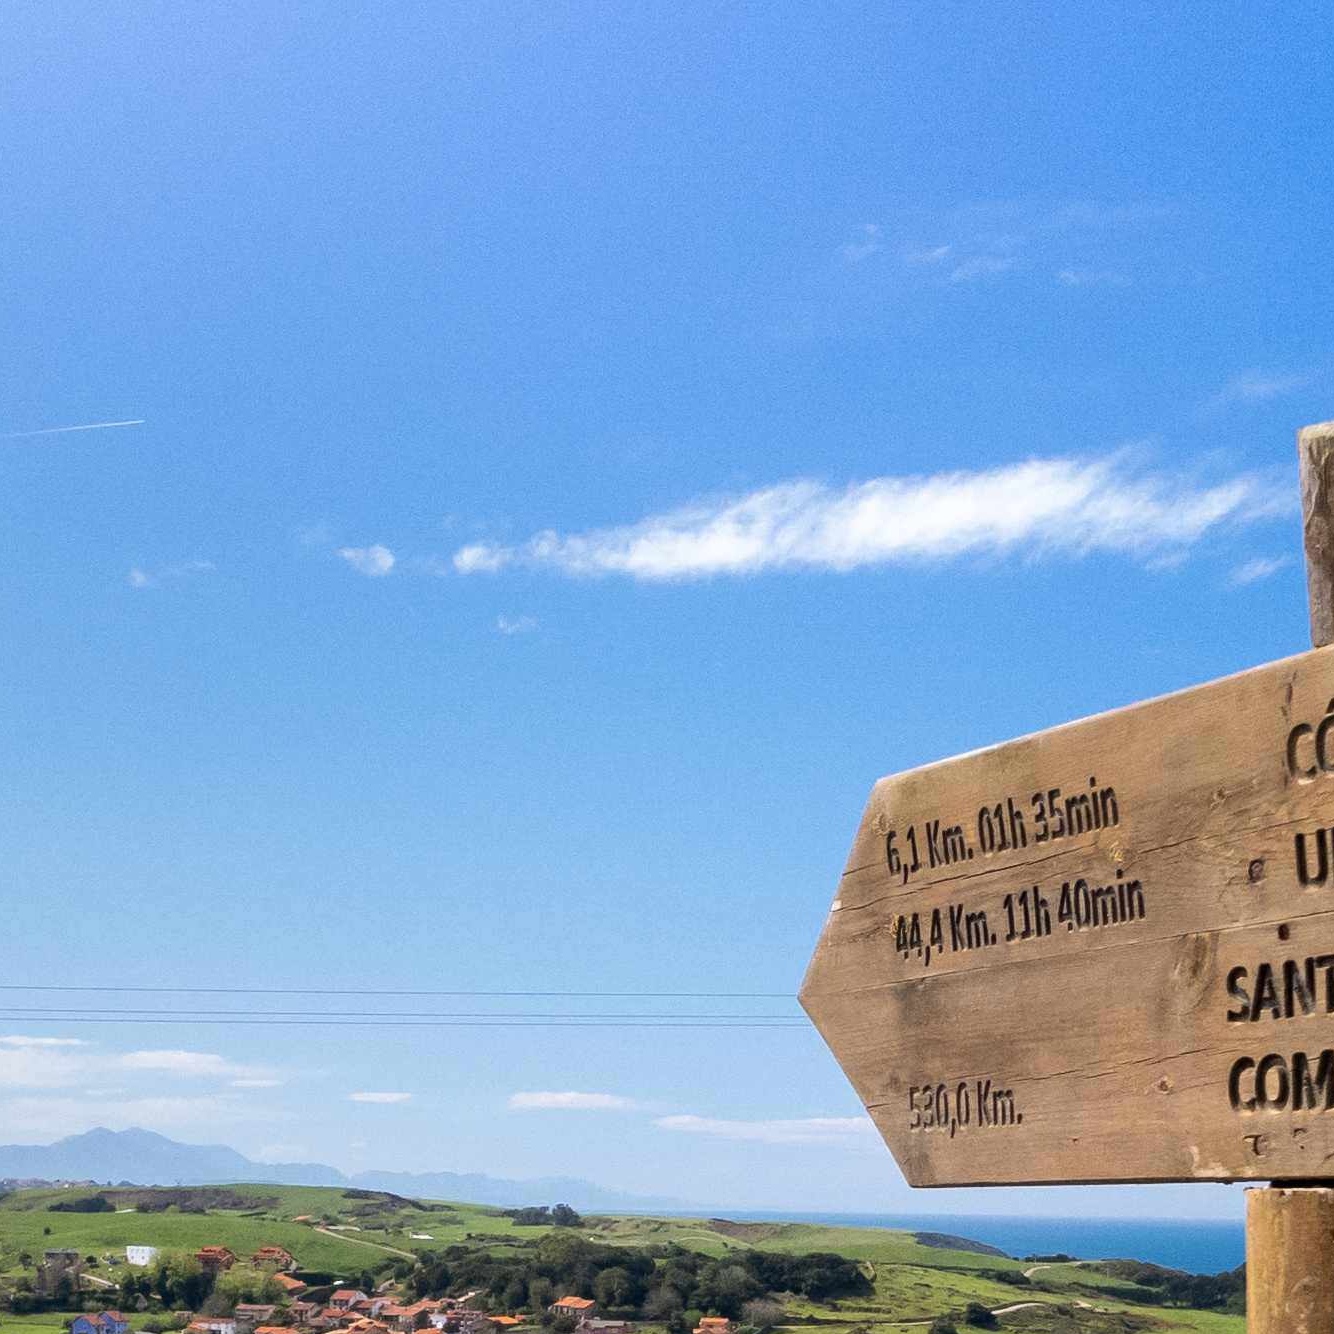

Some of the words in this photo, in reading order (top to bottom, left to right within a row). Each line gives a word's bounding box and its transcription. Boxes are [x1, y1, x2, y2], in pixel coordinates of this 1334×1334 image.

[885, 828, 919, 884] 6,1
[928, 820, 974, 869] Km.
[978, 798, 1027, 856] 01h
[1032, 776, 1120, 845] 35min
[895, 908, 943, 966] 44,4
[950, 904, 997, 952] Km.
[1003, 886, 1052, 943] 11h
[1058, 869, 1146, 932] 40min
[909, 1081, 970, 1139] 530,0
[977, 1079, 1024, 1129] Km.
